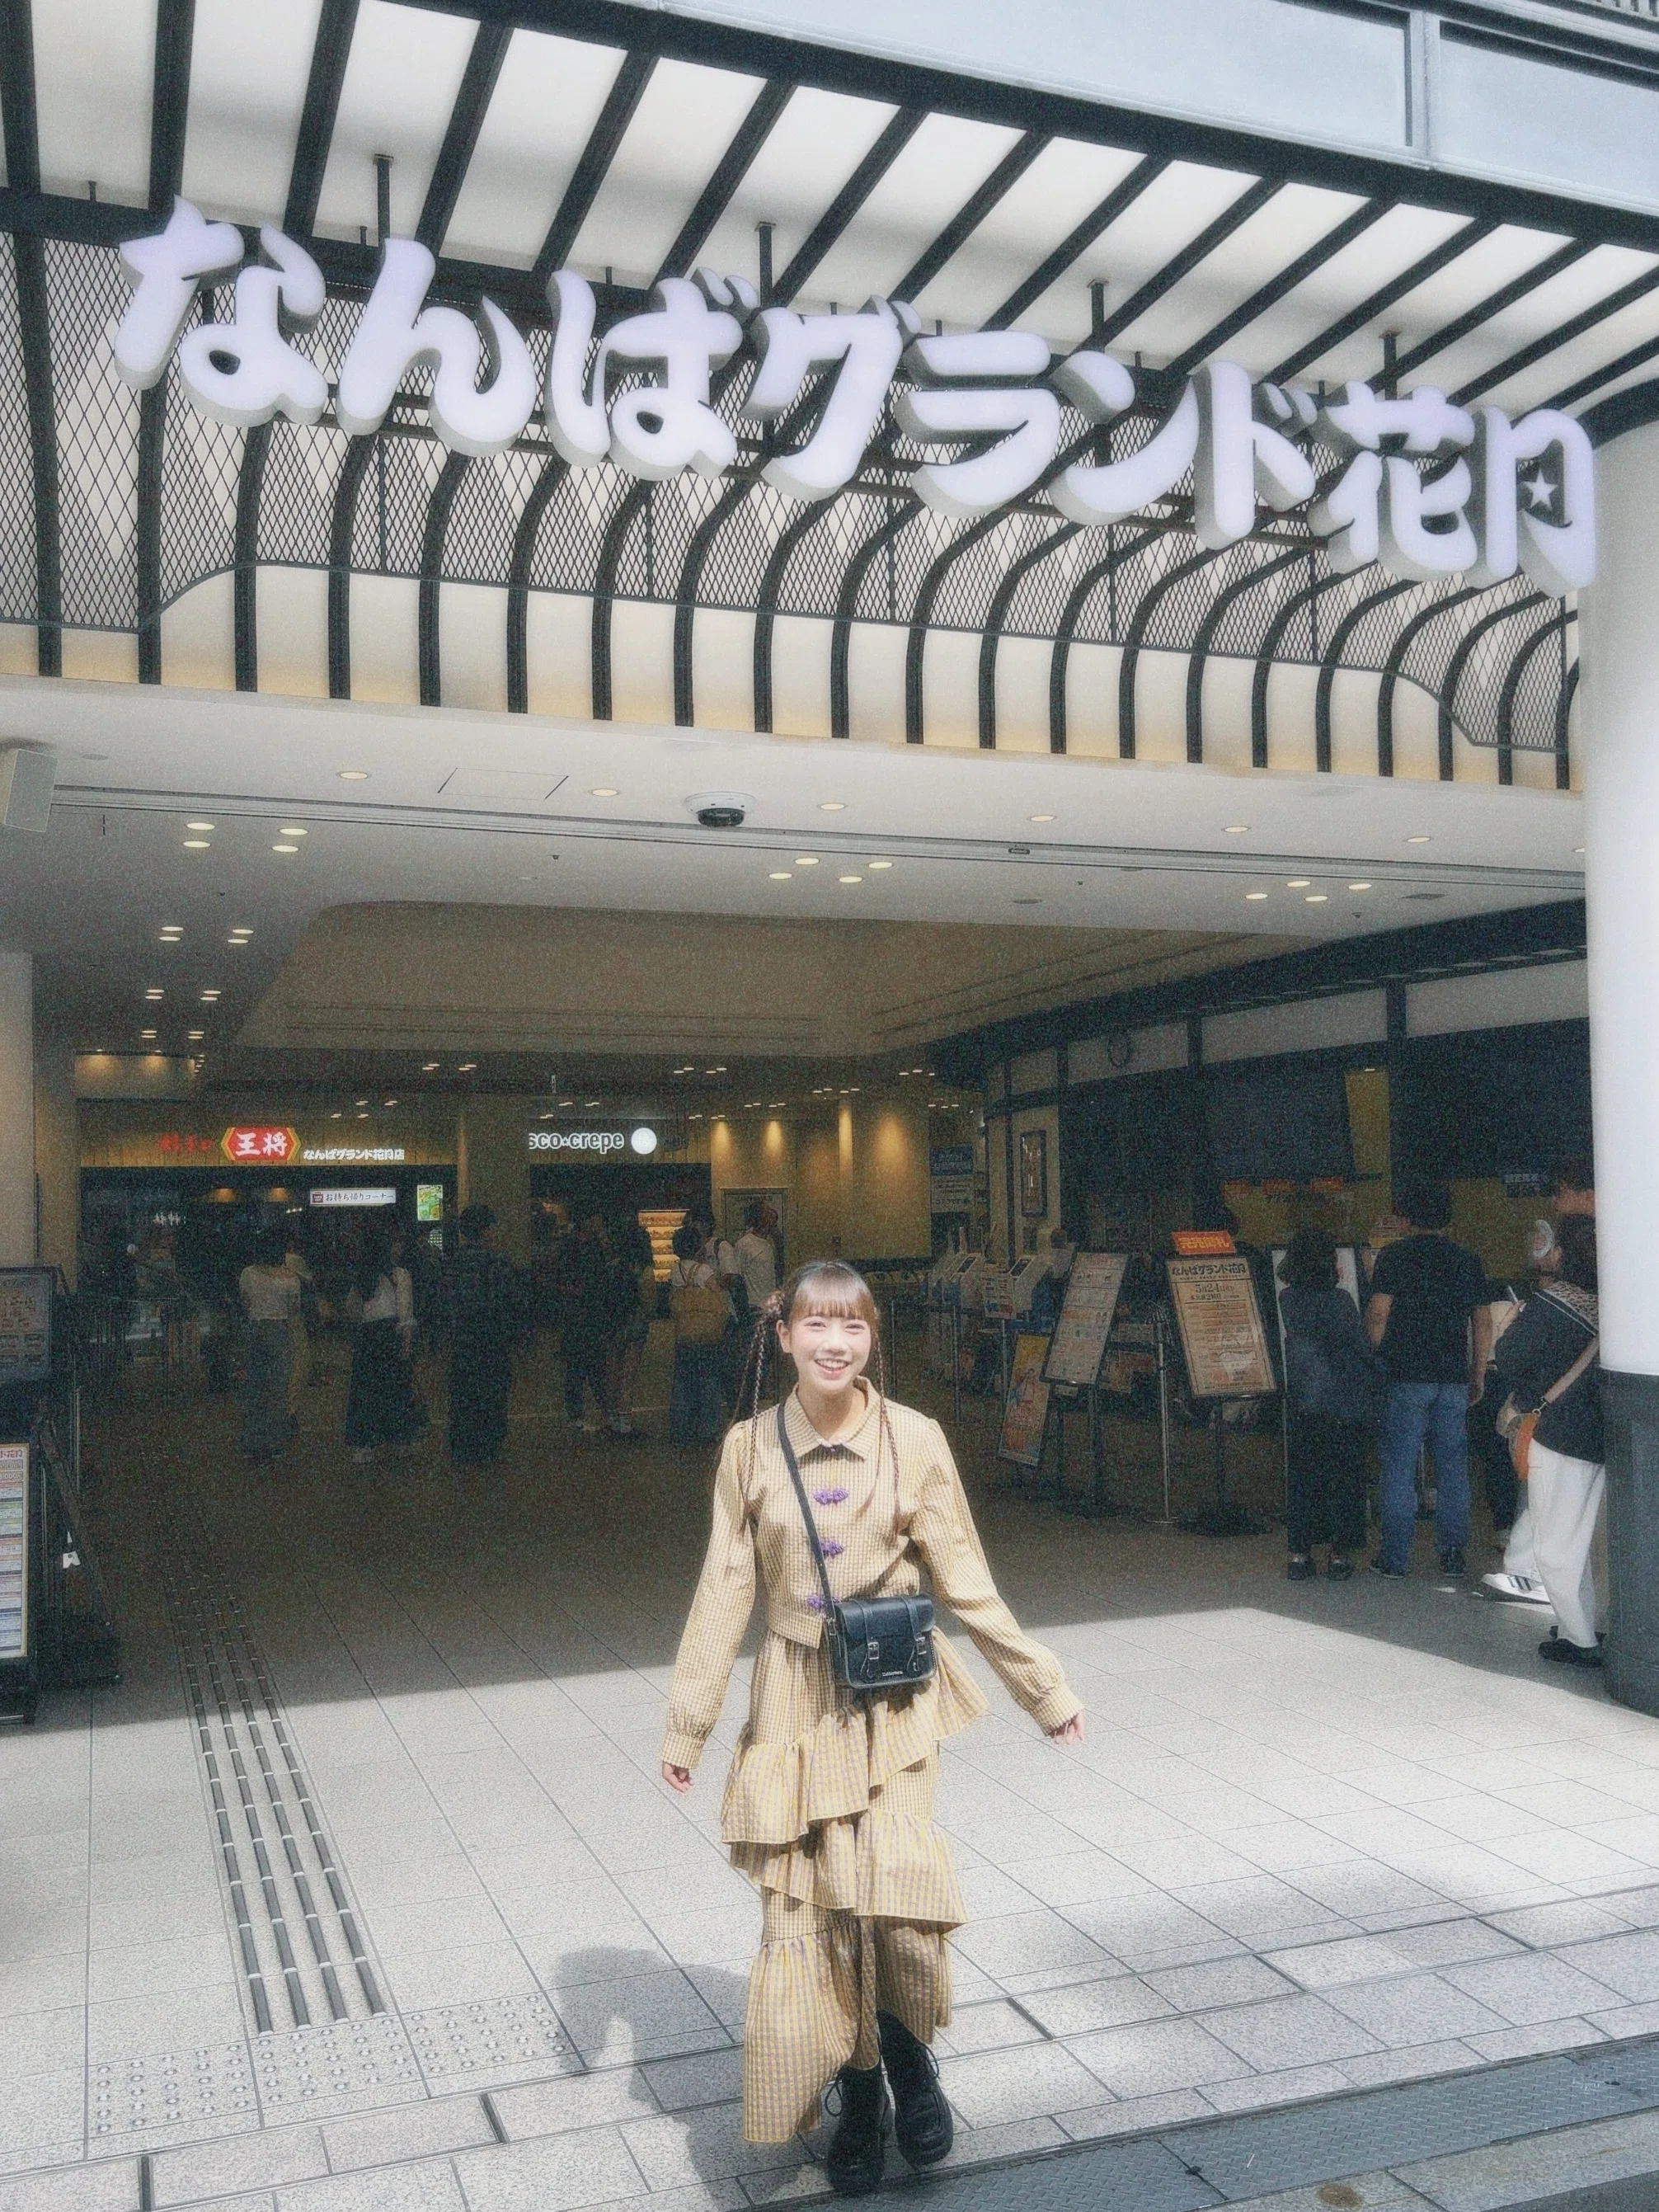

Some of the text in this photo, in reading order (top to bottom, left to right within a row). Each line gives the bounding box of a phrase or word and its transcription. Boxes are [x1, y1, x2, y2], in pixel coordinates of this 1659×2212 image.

[114, 195, 1597, 598] なんばグランド花月
[235, 1132, 289, 1156] 王将
[303, 1147, 405, 1161] なんばグランド花月店
[325, 1192, 395, 1202] お持ち帰りコーナー
[1172, 1263, 1247, 1277] なんばグランド花月
